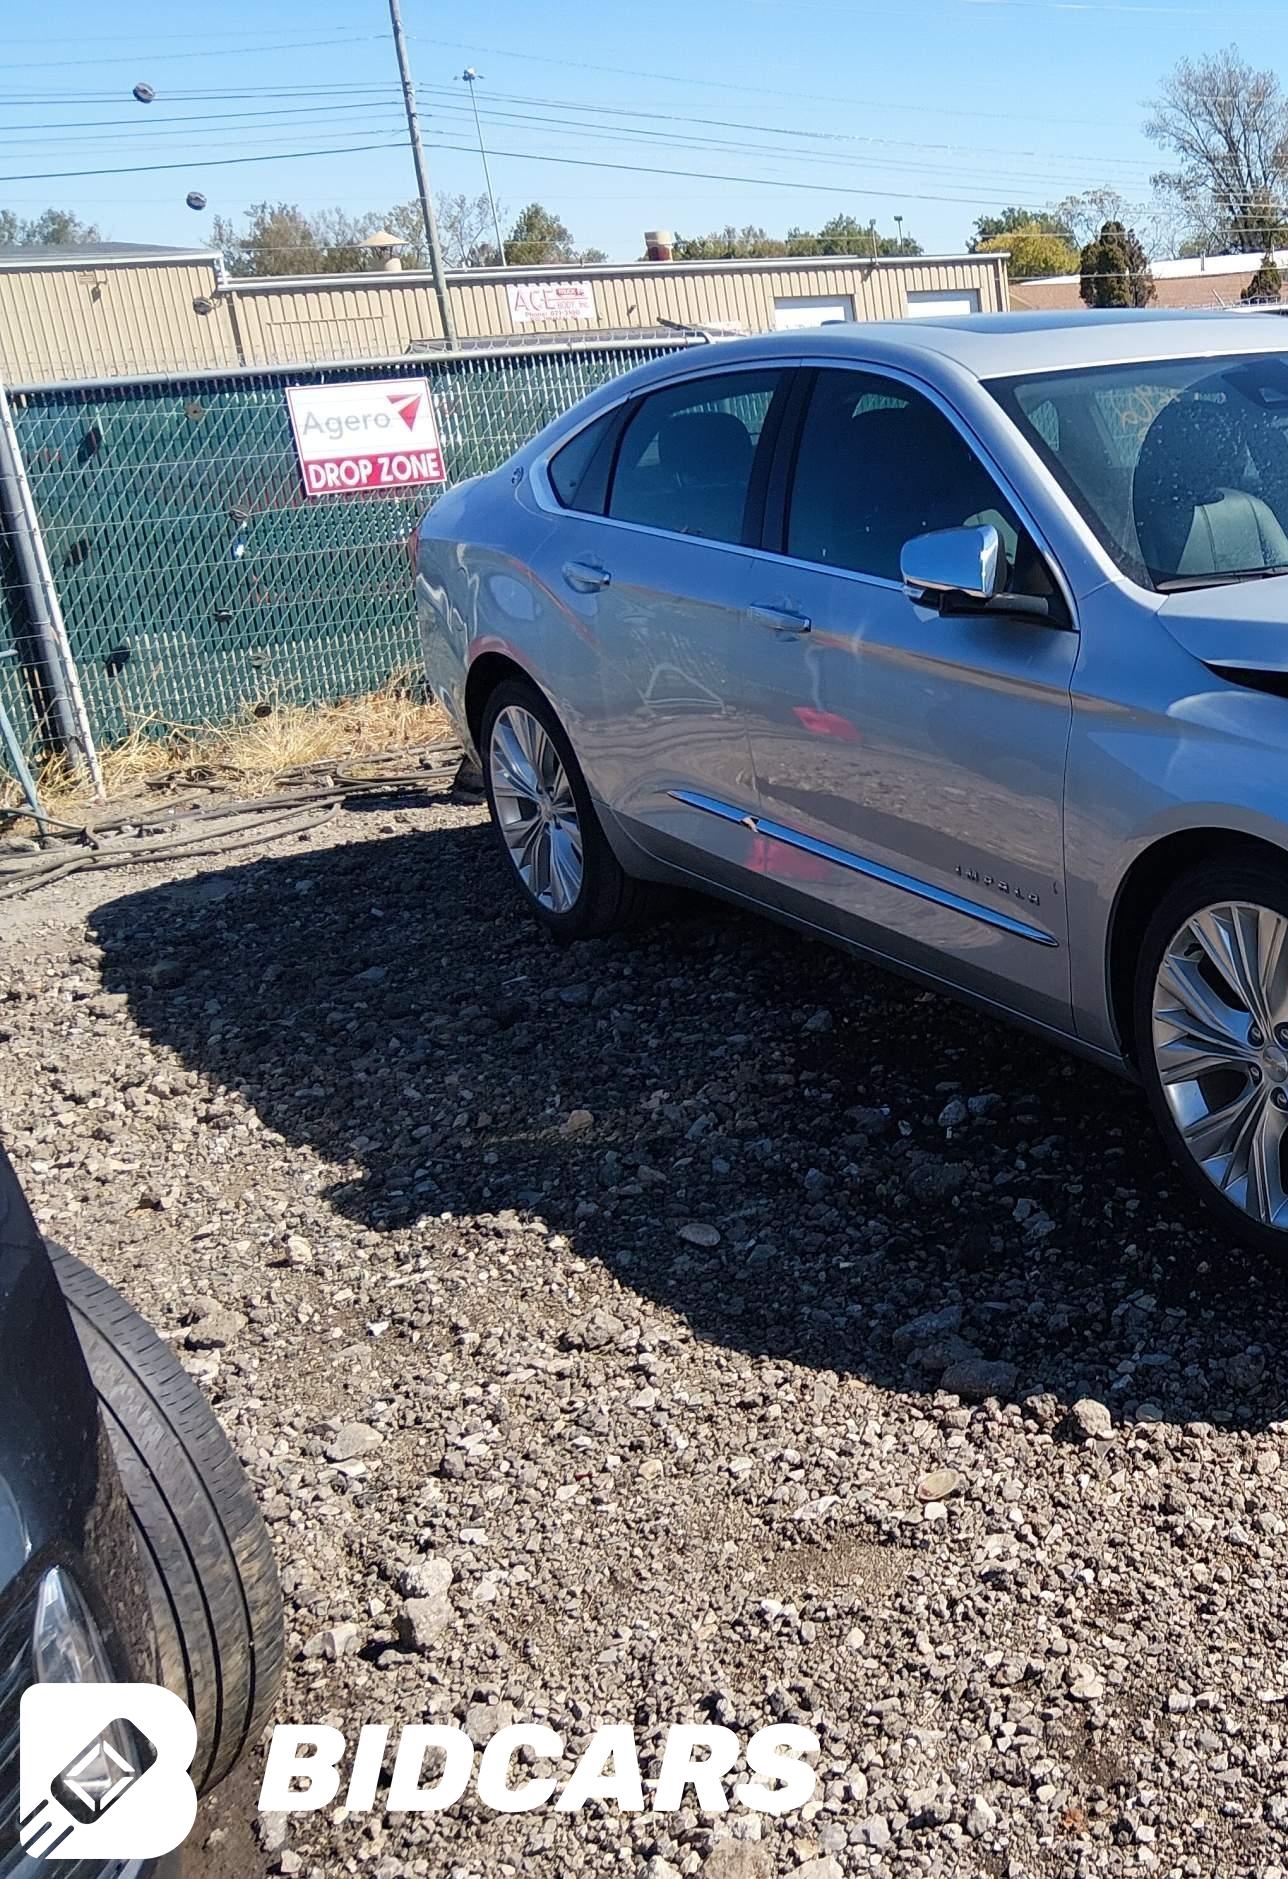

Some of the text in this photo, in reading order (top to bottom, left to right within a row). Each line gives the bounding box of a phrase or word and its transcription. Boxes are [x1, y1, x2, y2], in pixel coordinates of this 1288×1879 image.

[515, 288, 556, 311] ACE
[302, 411, 391, 440] Agero
[308, 452, 441, 489] DROP ZONE
